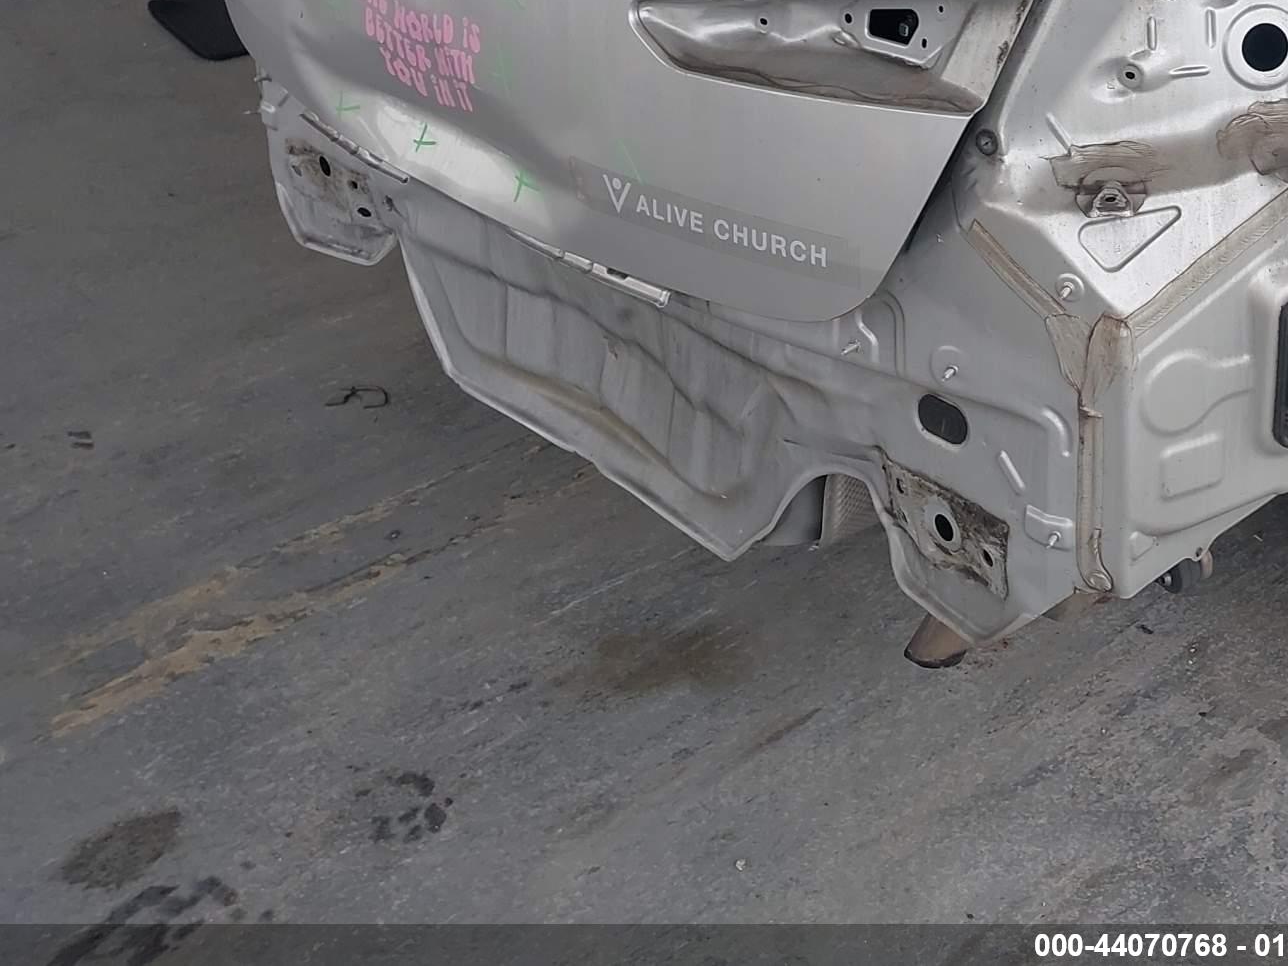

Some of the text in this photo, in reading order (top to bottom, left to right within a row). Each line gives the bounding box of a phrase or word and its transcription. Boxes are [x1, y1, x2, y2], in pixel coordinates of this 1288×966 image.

[365, 7, 431, 72] BETTER
[394, 0, 454, 44] WORLD
[379, 47, 428, 97] YOU
[636, 194, 828, 268] ALIVE CHURCH
